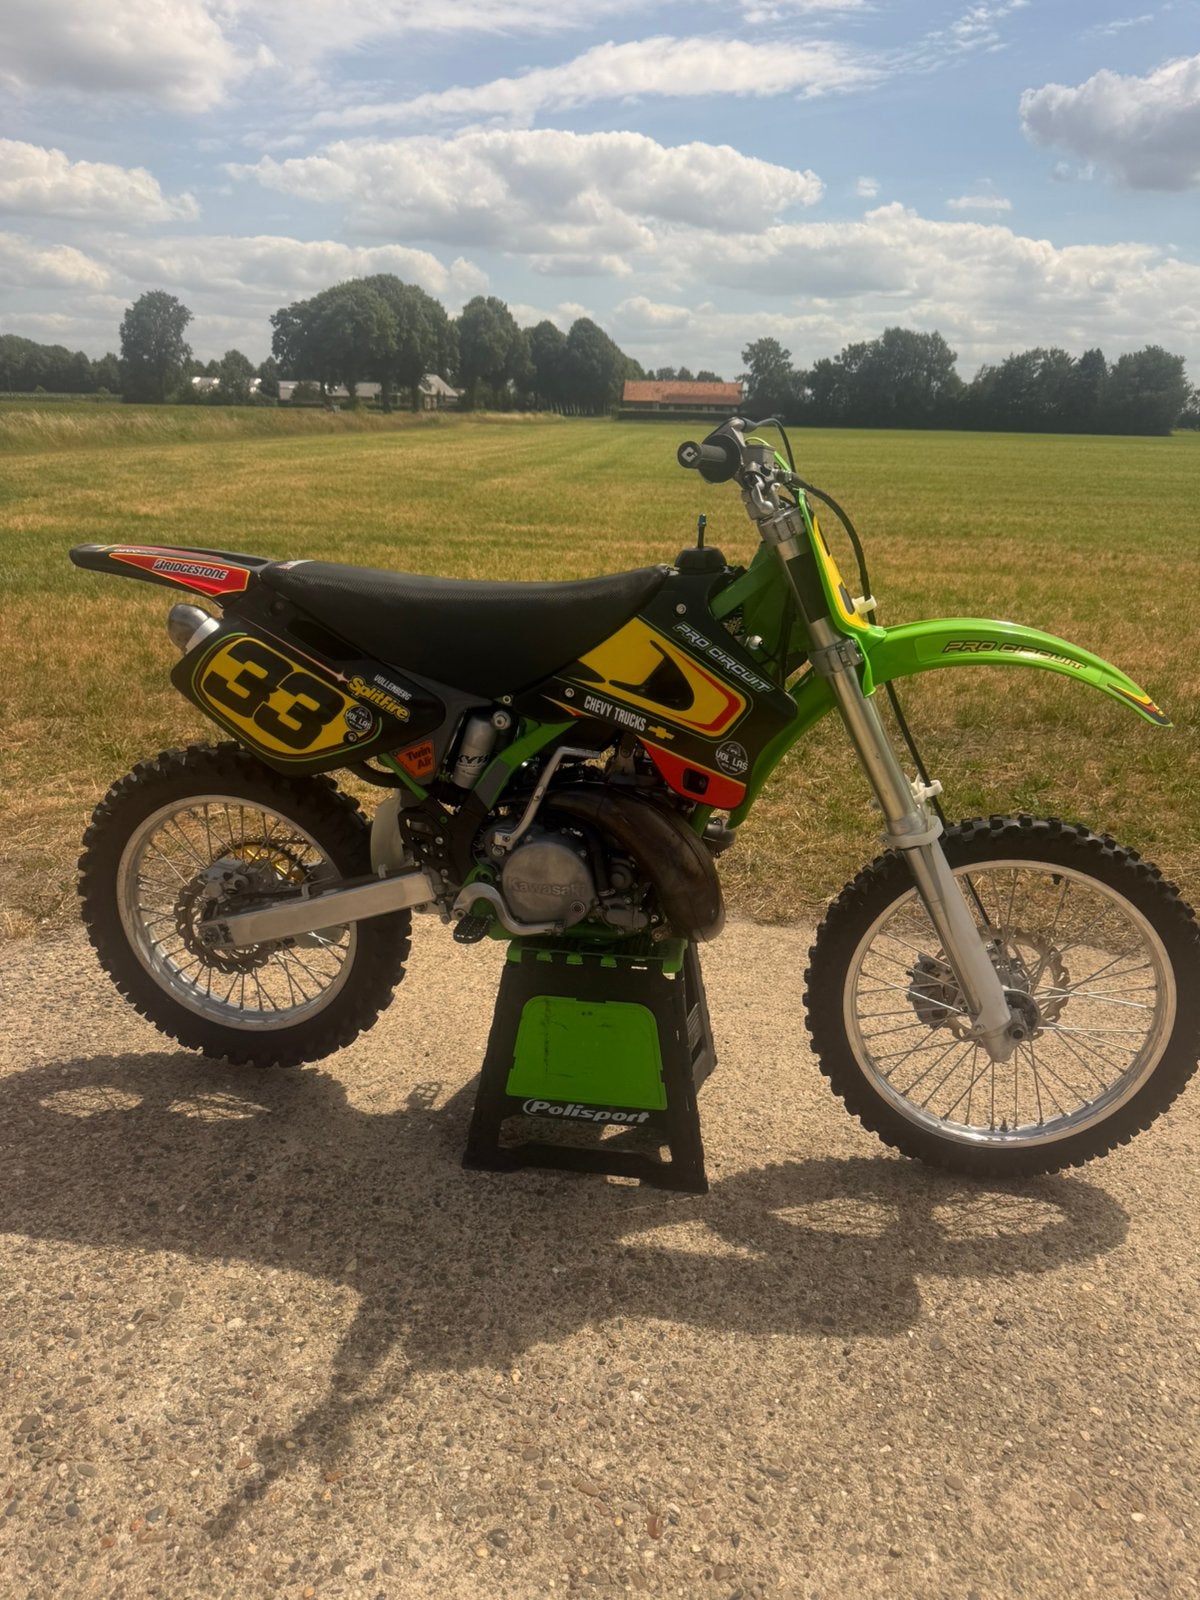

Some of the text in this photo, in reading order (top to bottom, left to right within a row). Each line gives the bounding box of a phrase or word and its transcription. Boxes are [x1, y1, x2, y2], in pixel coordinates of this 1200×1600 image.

[153, 559, 228, 581] BRIDGESTONE
[674, 622, 772, 692] PRO CIRCUIT
[942, 640, 997, 653] PRO
[201, 638, 346, 751] 33
[347, 675, 411, 721] SplitFire
[374, 674, 413, 701] VOLLENBERG
[584, 695, 647, 732] CHEVY TRUCKS
[405, 746, 431, 761] Twin
[417, 756, 432, 770] Air
[524, 1099, 650, 1124] Polisport
